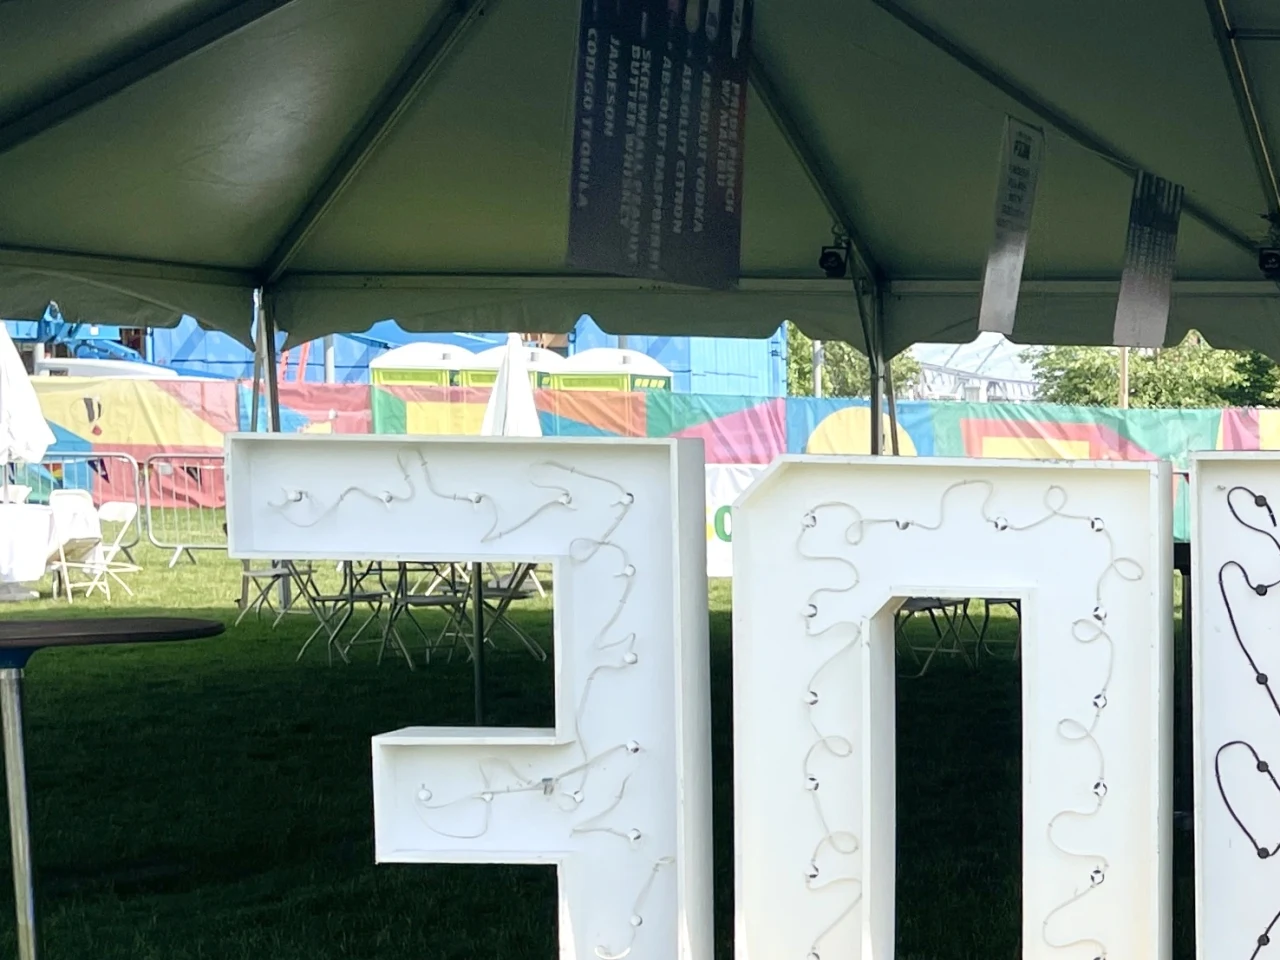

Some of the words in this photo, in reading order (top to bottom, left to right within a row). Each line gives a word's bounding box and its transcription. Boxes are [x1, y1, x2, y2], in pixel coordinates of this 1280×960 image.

[603, 35, 621, 136] JAMESON
[625, 45, 640, 130] BUTTER
[656, 56, 672, 150] ABSOLUT
[676, 64, 692, 155] ABSOLUT
[696, 70, 711, 163] ABSOLUT
[728, 82, 740, 143] PRIDE
[577, 117, 592, 208] TEQUILA
[715, 110, 729, 187] MALIBU
[724, 146, 738, 214] PUNCH
[672, 159, 687, 234] CITRON
[692, 165, 706, 233] VODKA
